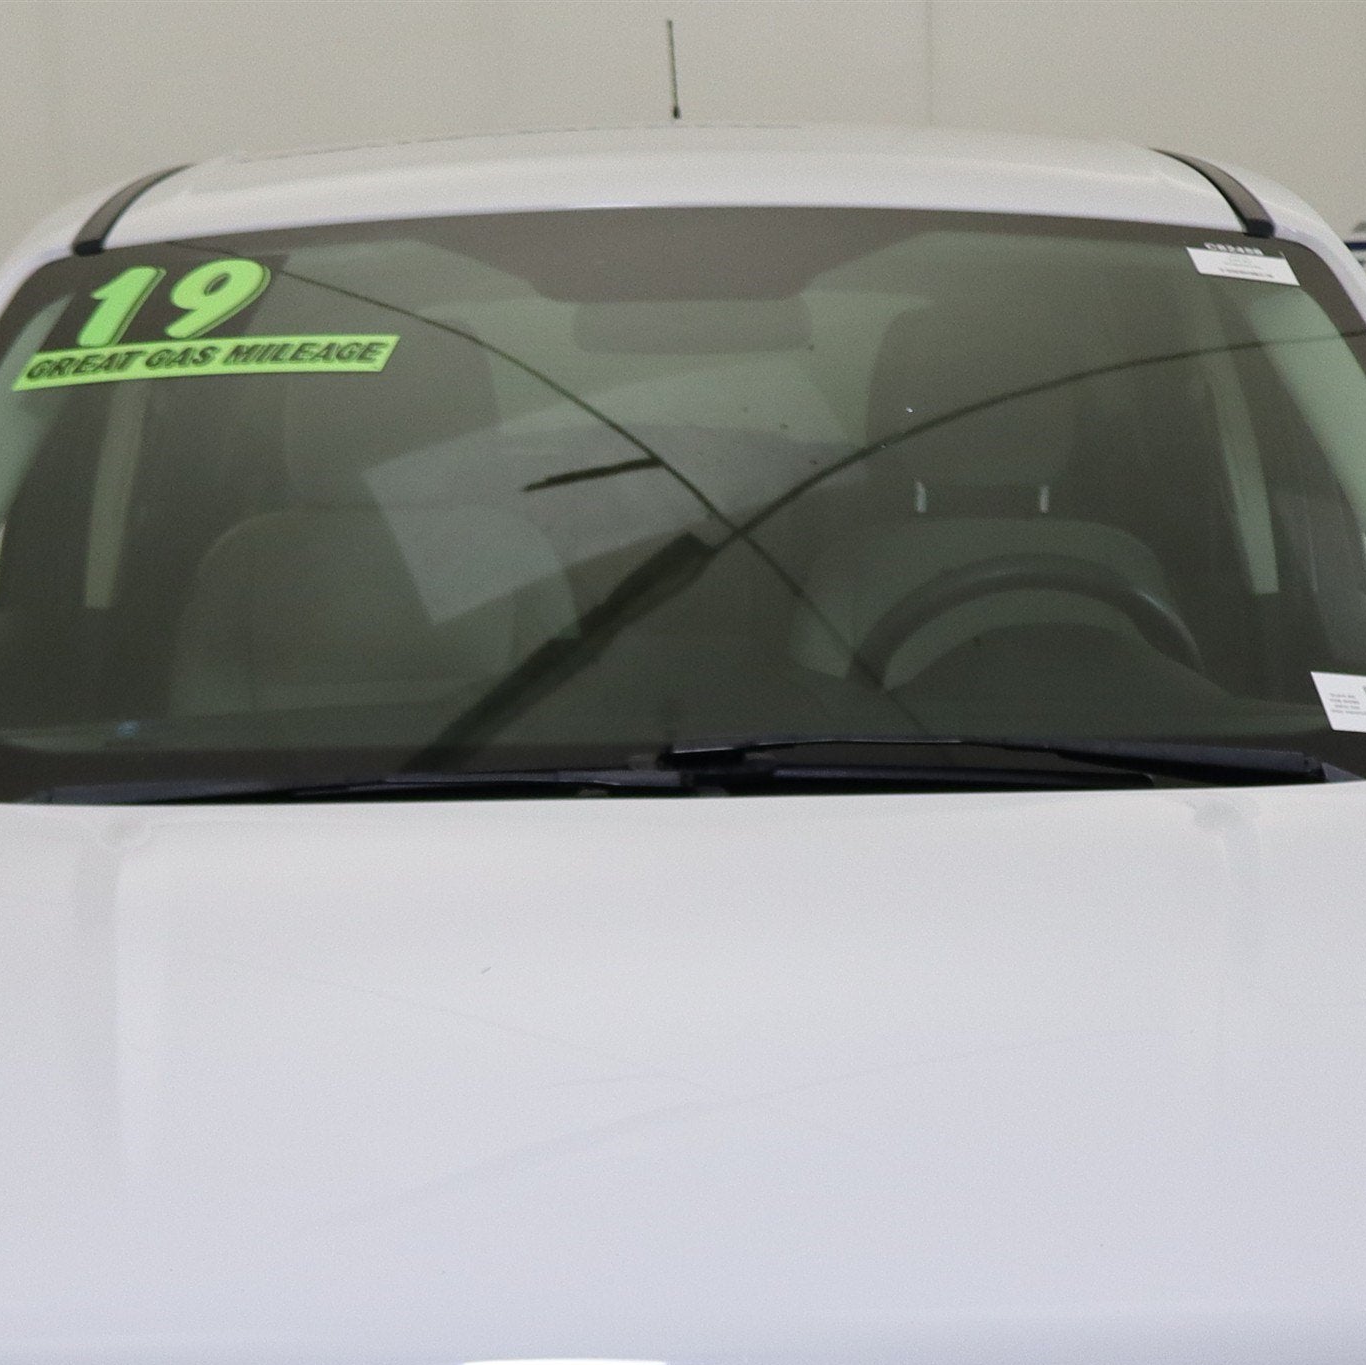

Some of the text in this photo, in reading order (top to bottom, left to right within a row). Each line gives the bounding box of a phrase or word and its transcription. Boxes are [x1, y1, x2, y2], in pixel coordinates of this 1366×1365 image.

[77, 258, 272, 348] 19
[26, 342, 383, 380] GREAT GAS MILEAGE
